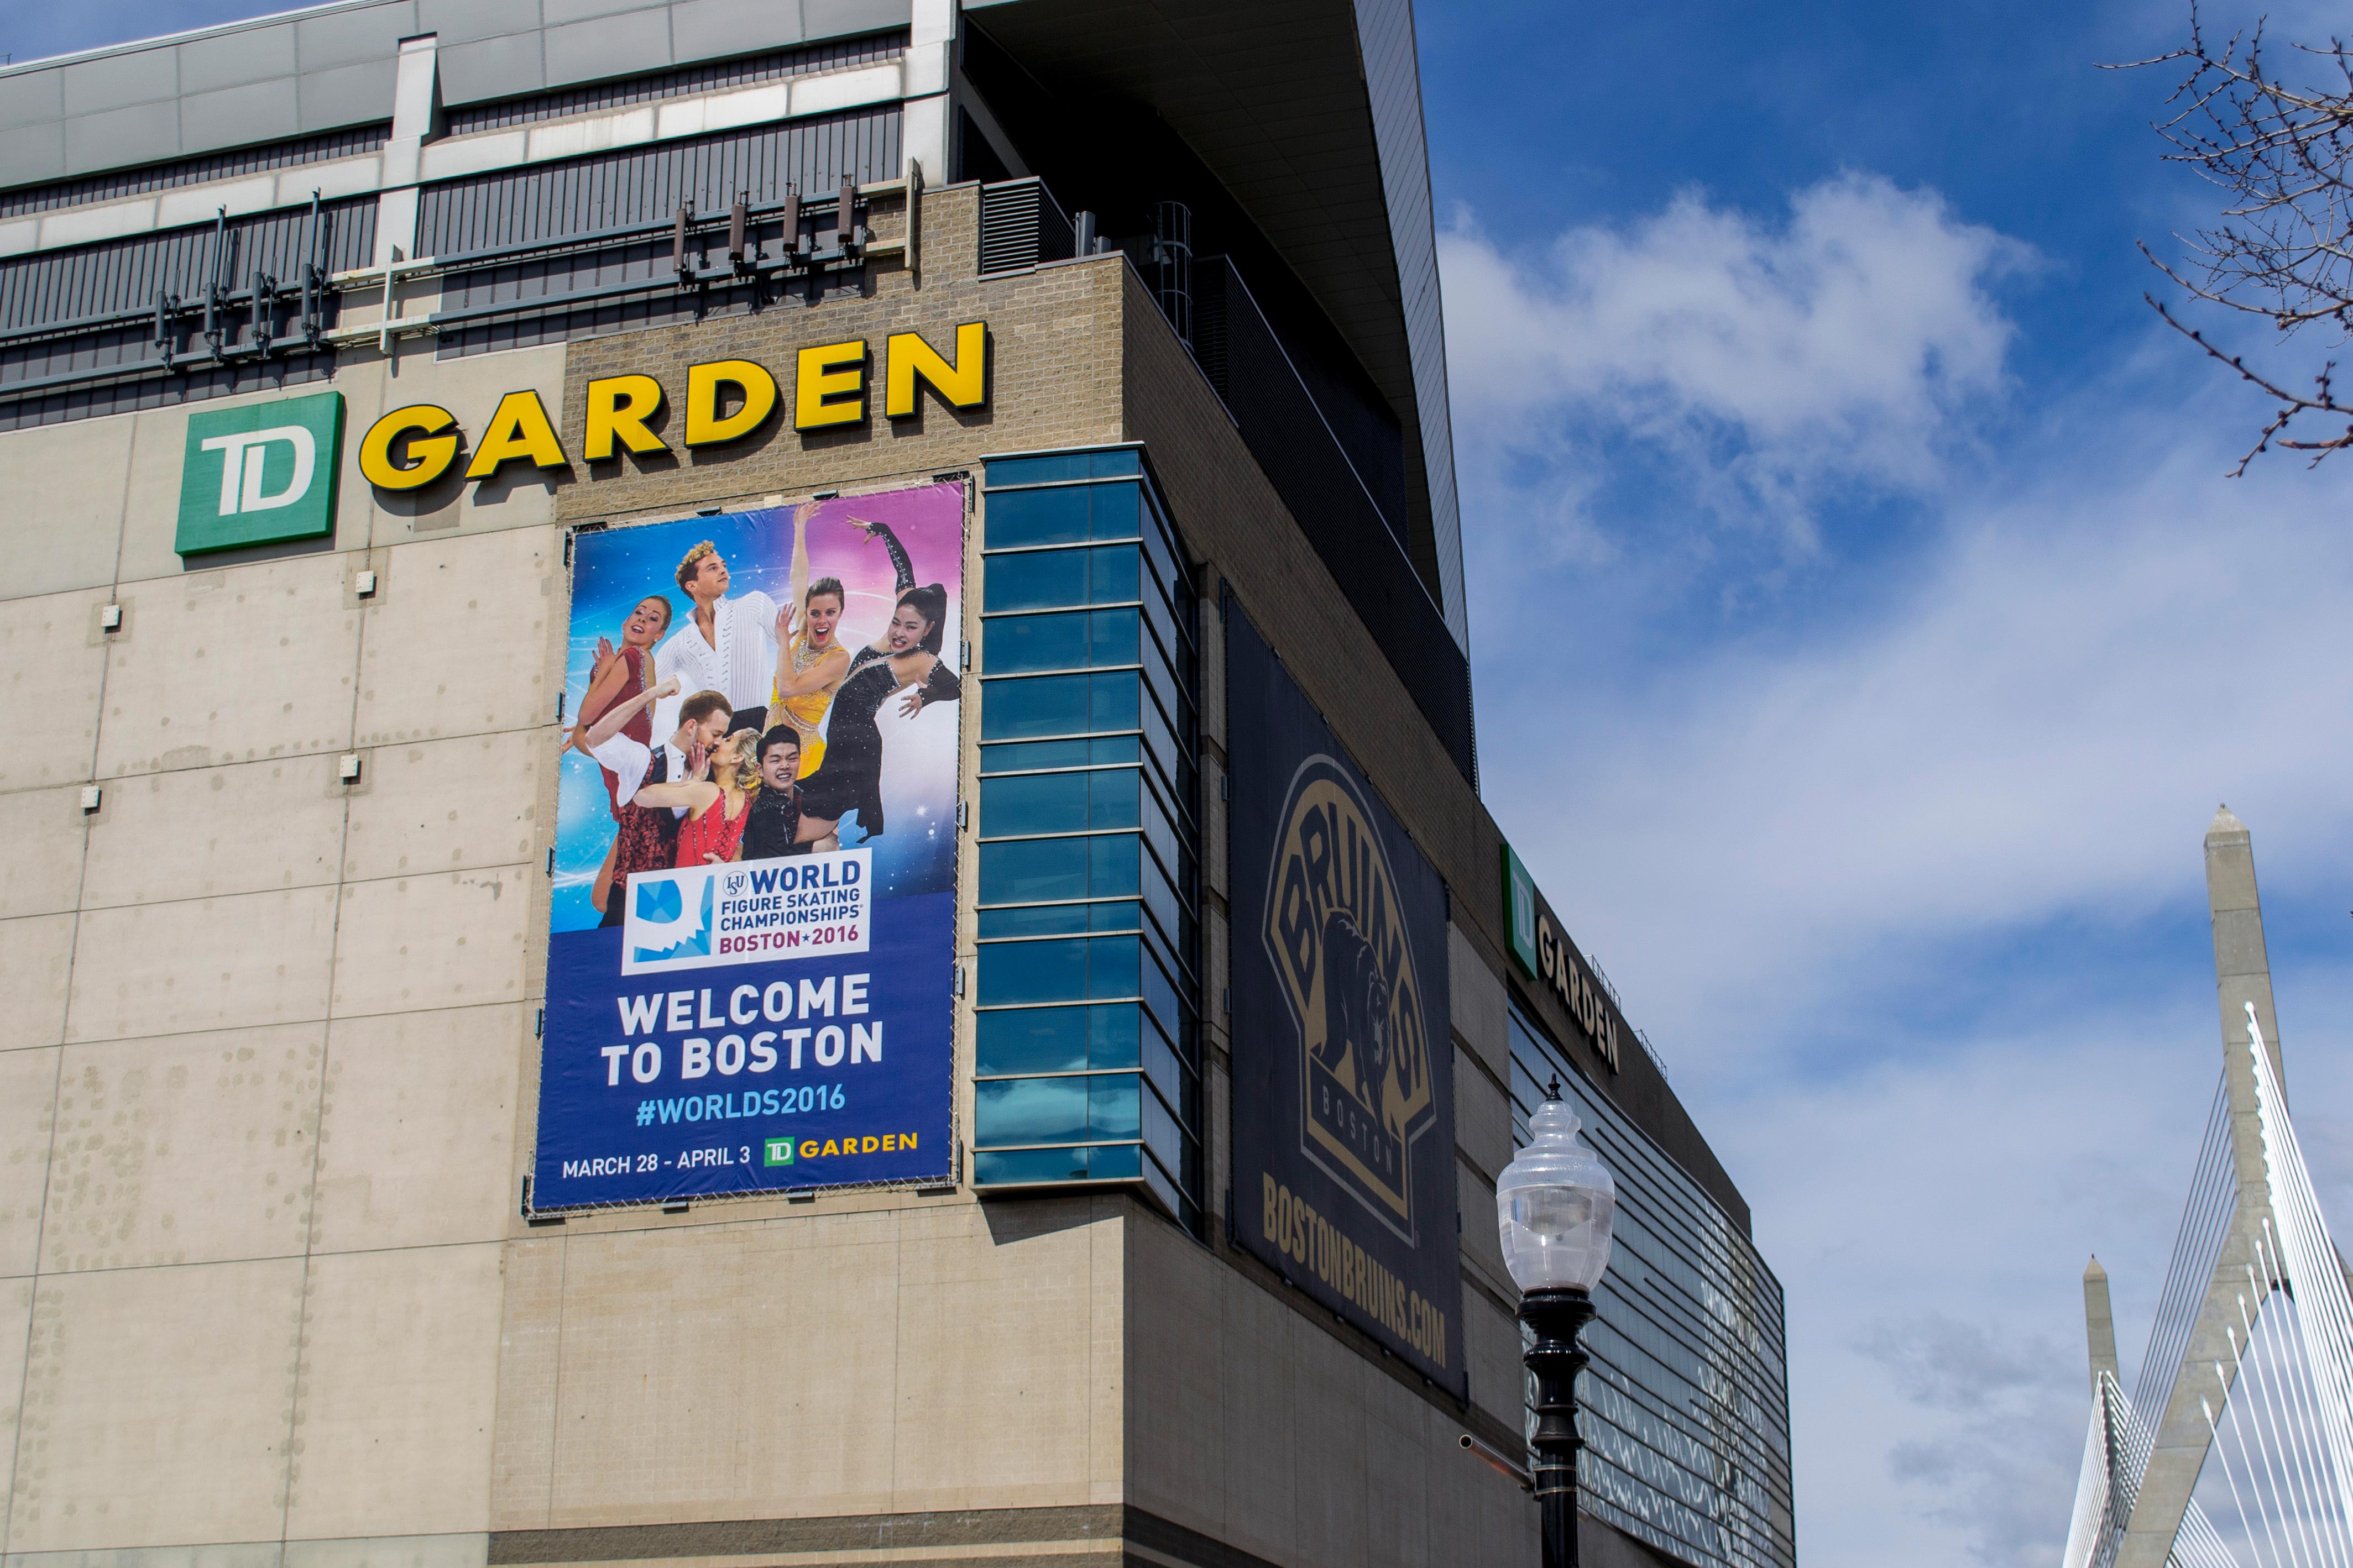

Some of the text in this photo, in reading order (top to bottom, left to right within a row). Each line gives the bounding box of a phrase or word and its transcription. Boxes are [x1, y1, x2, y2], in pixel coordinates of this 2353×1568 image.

[201, 320, 987, 516] TD GARDEN
[721, 888, 860, 915] FIGURE SKATING
[726, 860, 860, 895] ISU WORLD
[720, 904, 860, 931] CHAMPIONSHIPS
[720, 925, 859, 954] BOSTON 2016
[1278, 801, 1421, 1103] BRUINS
[1512, 869, 1619, 1075] TD GARDEN
[617, 973, 870, 1036] WELCOME
[601, 1021, 883, 1086] TO BOSTON
[636, 1084, 846, 1126] #WORLDS2016
[1322, 1085, 1392, 1176] BOSTON
[562, 1155, 631, 1178] MARCH
[636, 1153, 659, 1173] 28
[677, 1146, 734, 1168] APRIL
[739, 1146, 751, 1163] 3
[767, 1132, 918, 1162] TD GARDEN
[1263, 1171, 1447, 1369] BOSTONBRUINS.COM
